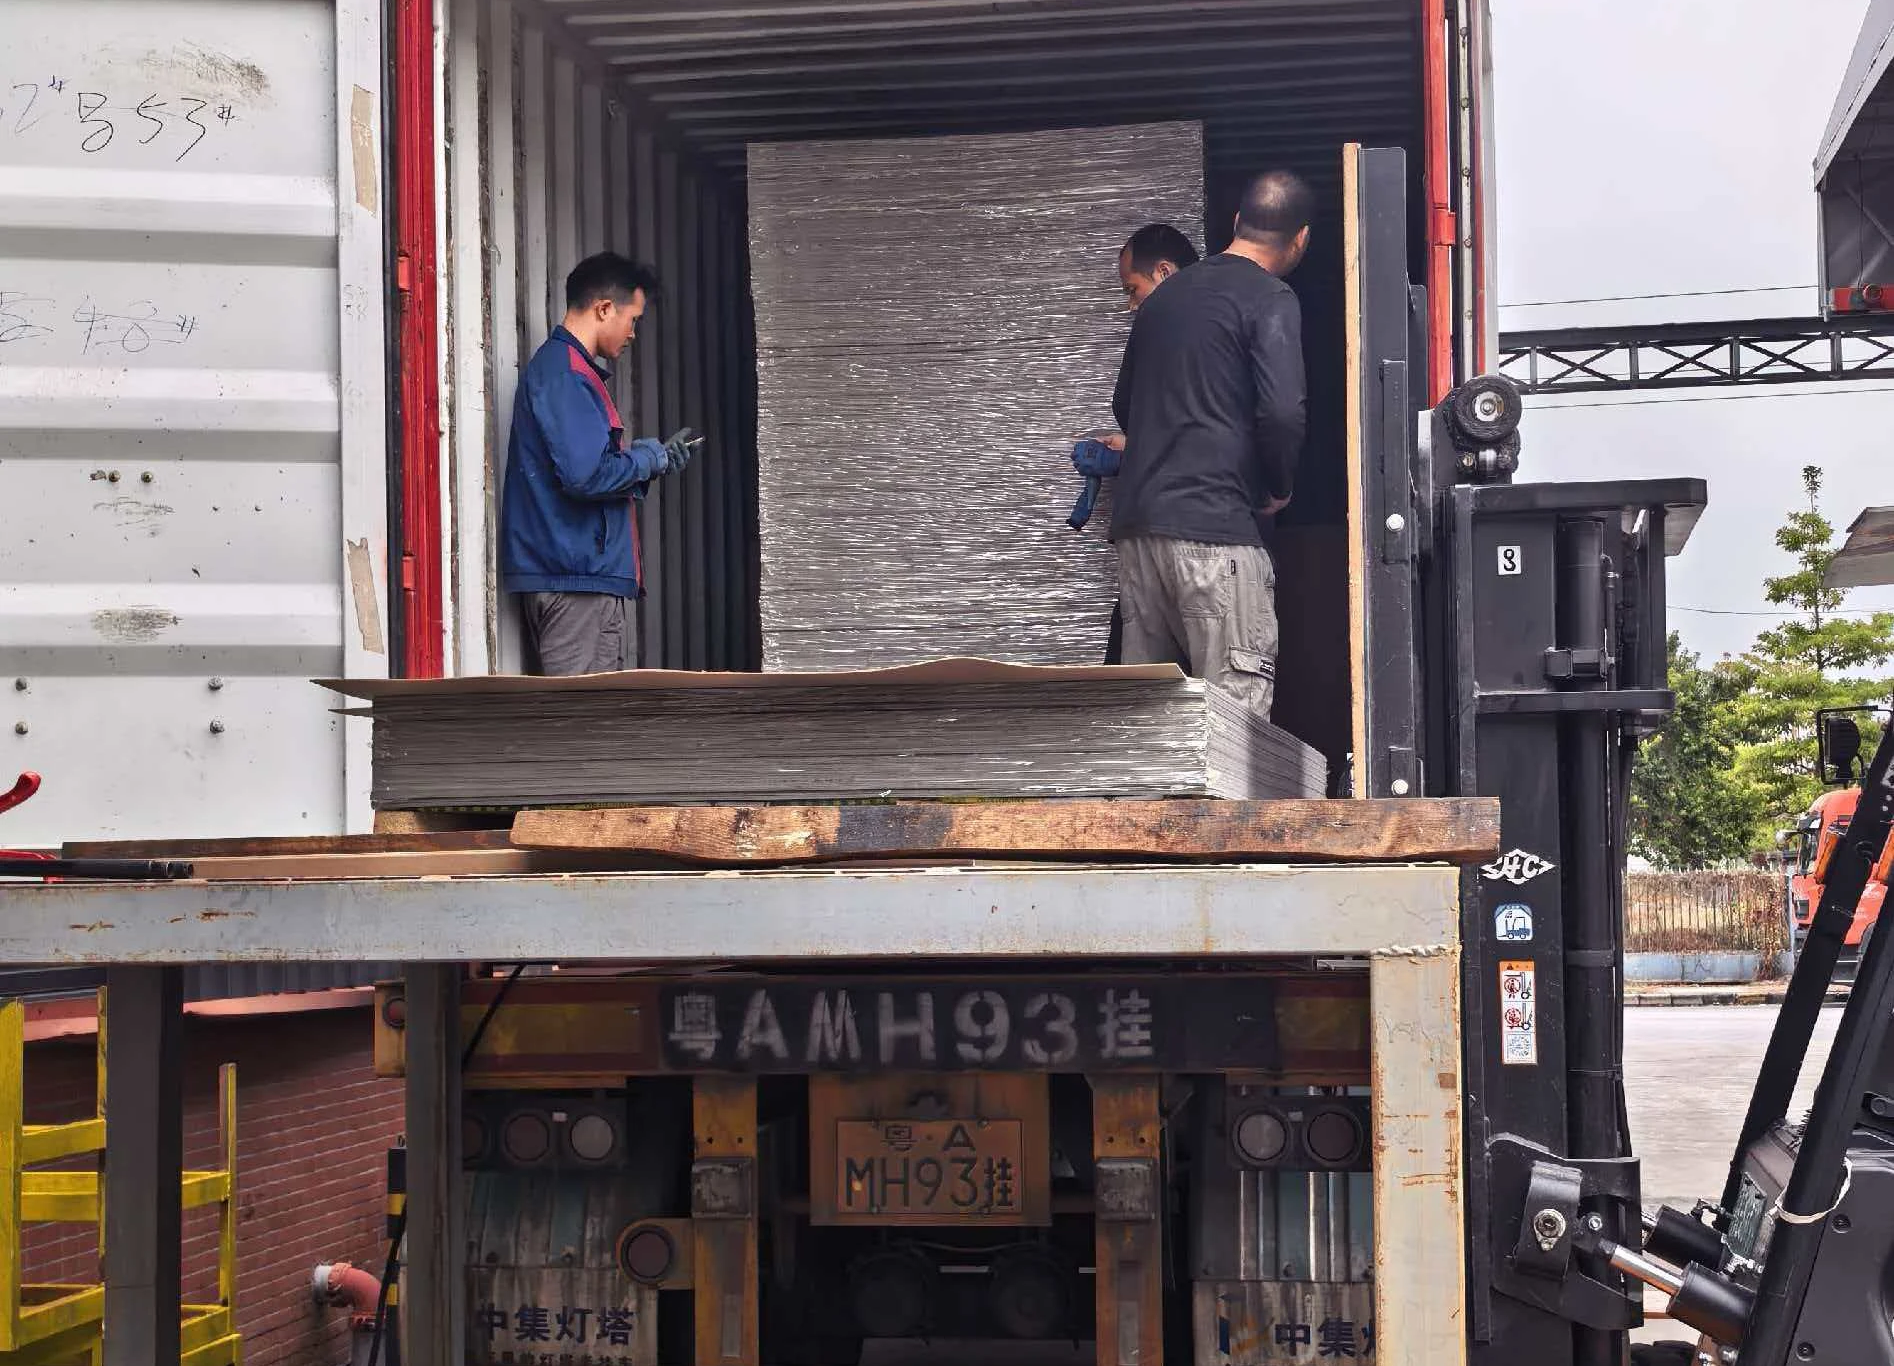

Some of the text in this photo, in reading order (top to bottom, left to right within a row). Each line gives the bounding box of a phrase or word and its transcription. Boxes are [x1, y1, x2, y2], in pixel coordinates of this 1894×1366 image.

[668, 988, 1154, 1064] 粤AMH93挂
[846, 1156, 1015, 1207] MH93挂
[477, 1302, 636, 1346] 中集灯塔
